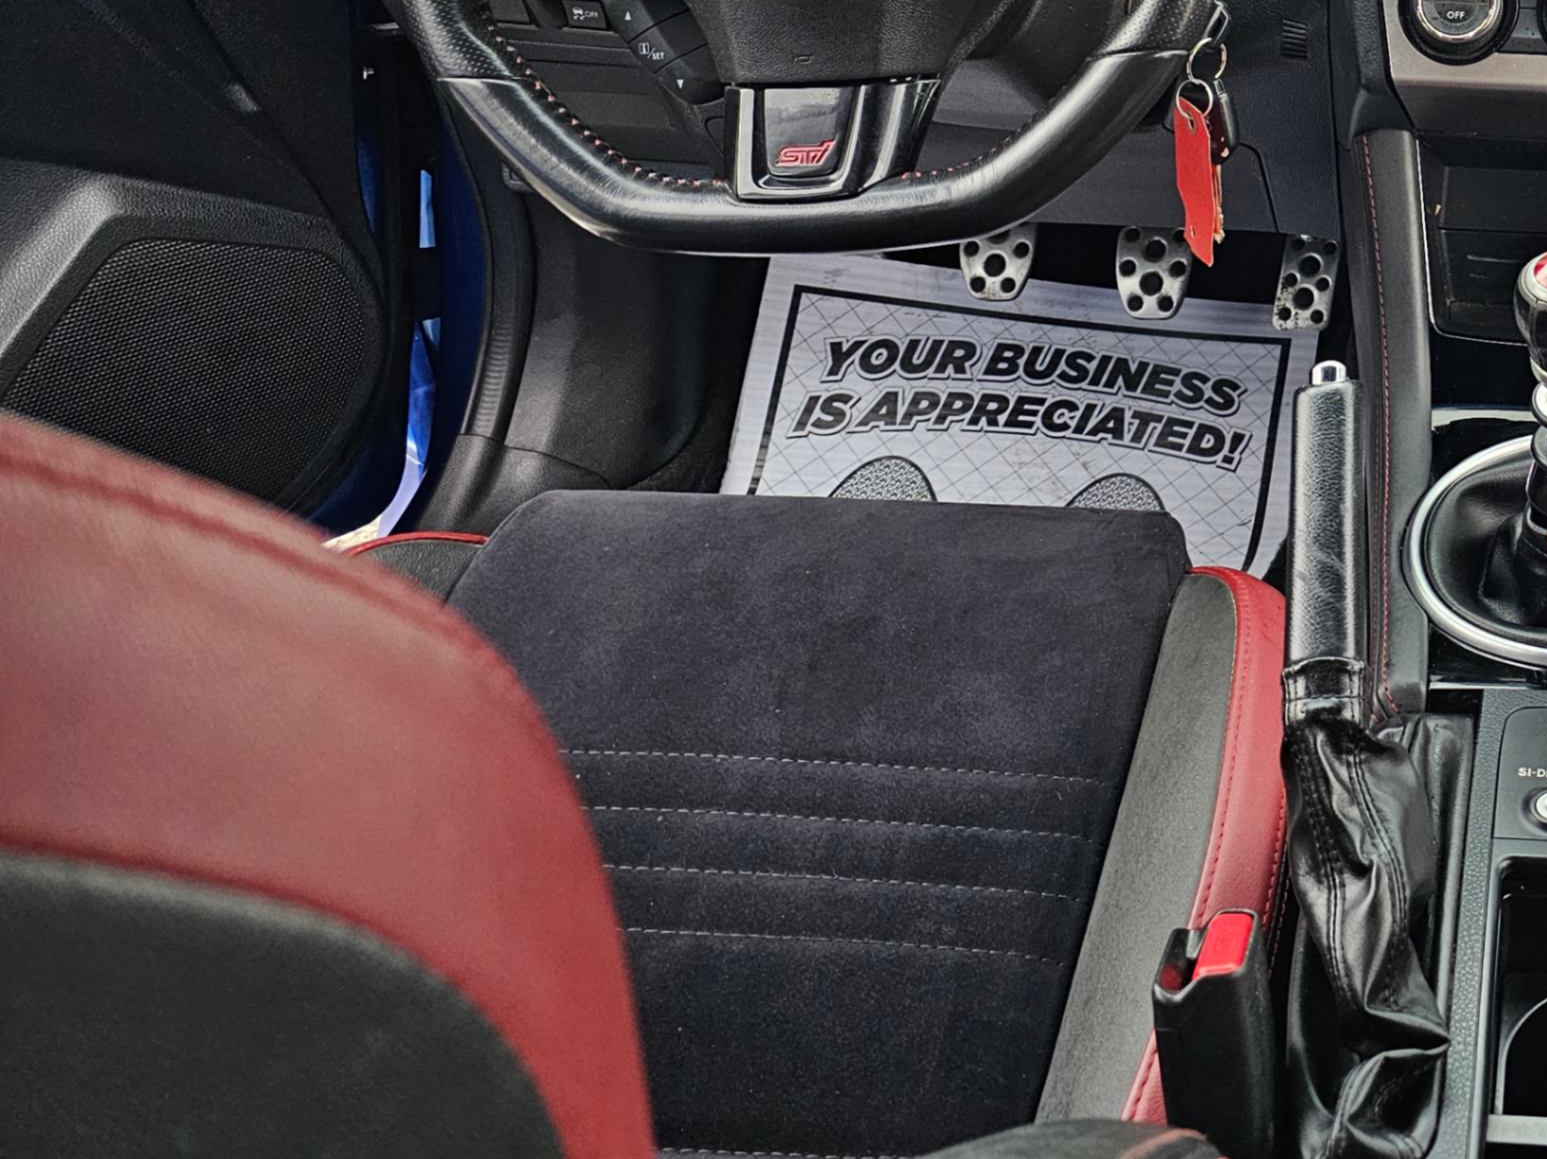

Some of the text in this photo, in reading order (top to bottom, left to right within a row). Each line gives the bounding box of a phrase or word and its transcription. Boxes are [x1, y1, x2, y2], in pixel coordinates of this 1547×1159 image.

[584, 10, 598, 18] OFF
[1447, 9, 1465, 20] OFF
[776, 140, 837, 168] STI
[823, 340, 1242, 413] YOUR BUSINESS
[800, 391, 1250, 467] IS APPRECIATED!
